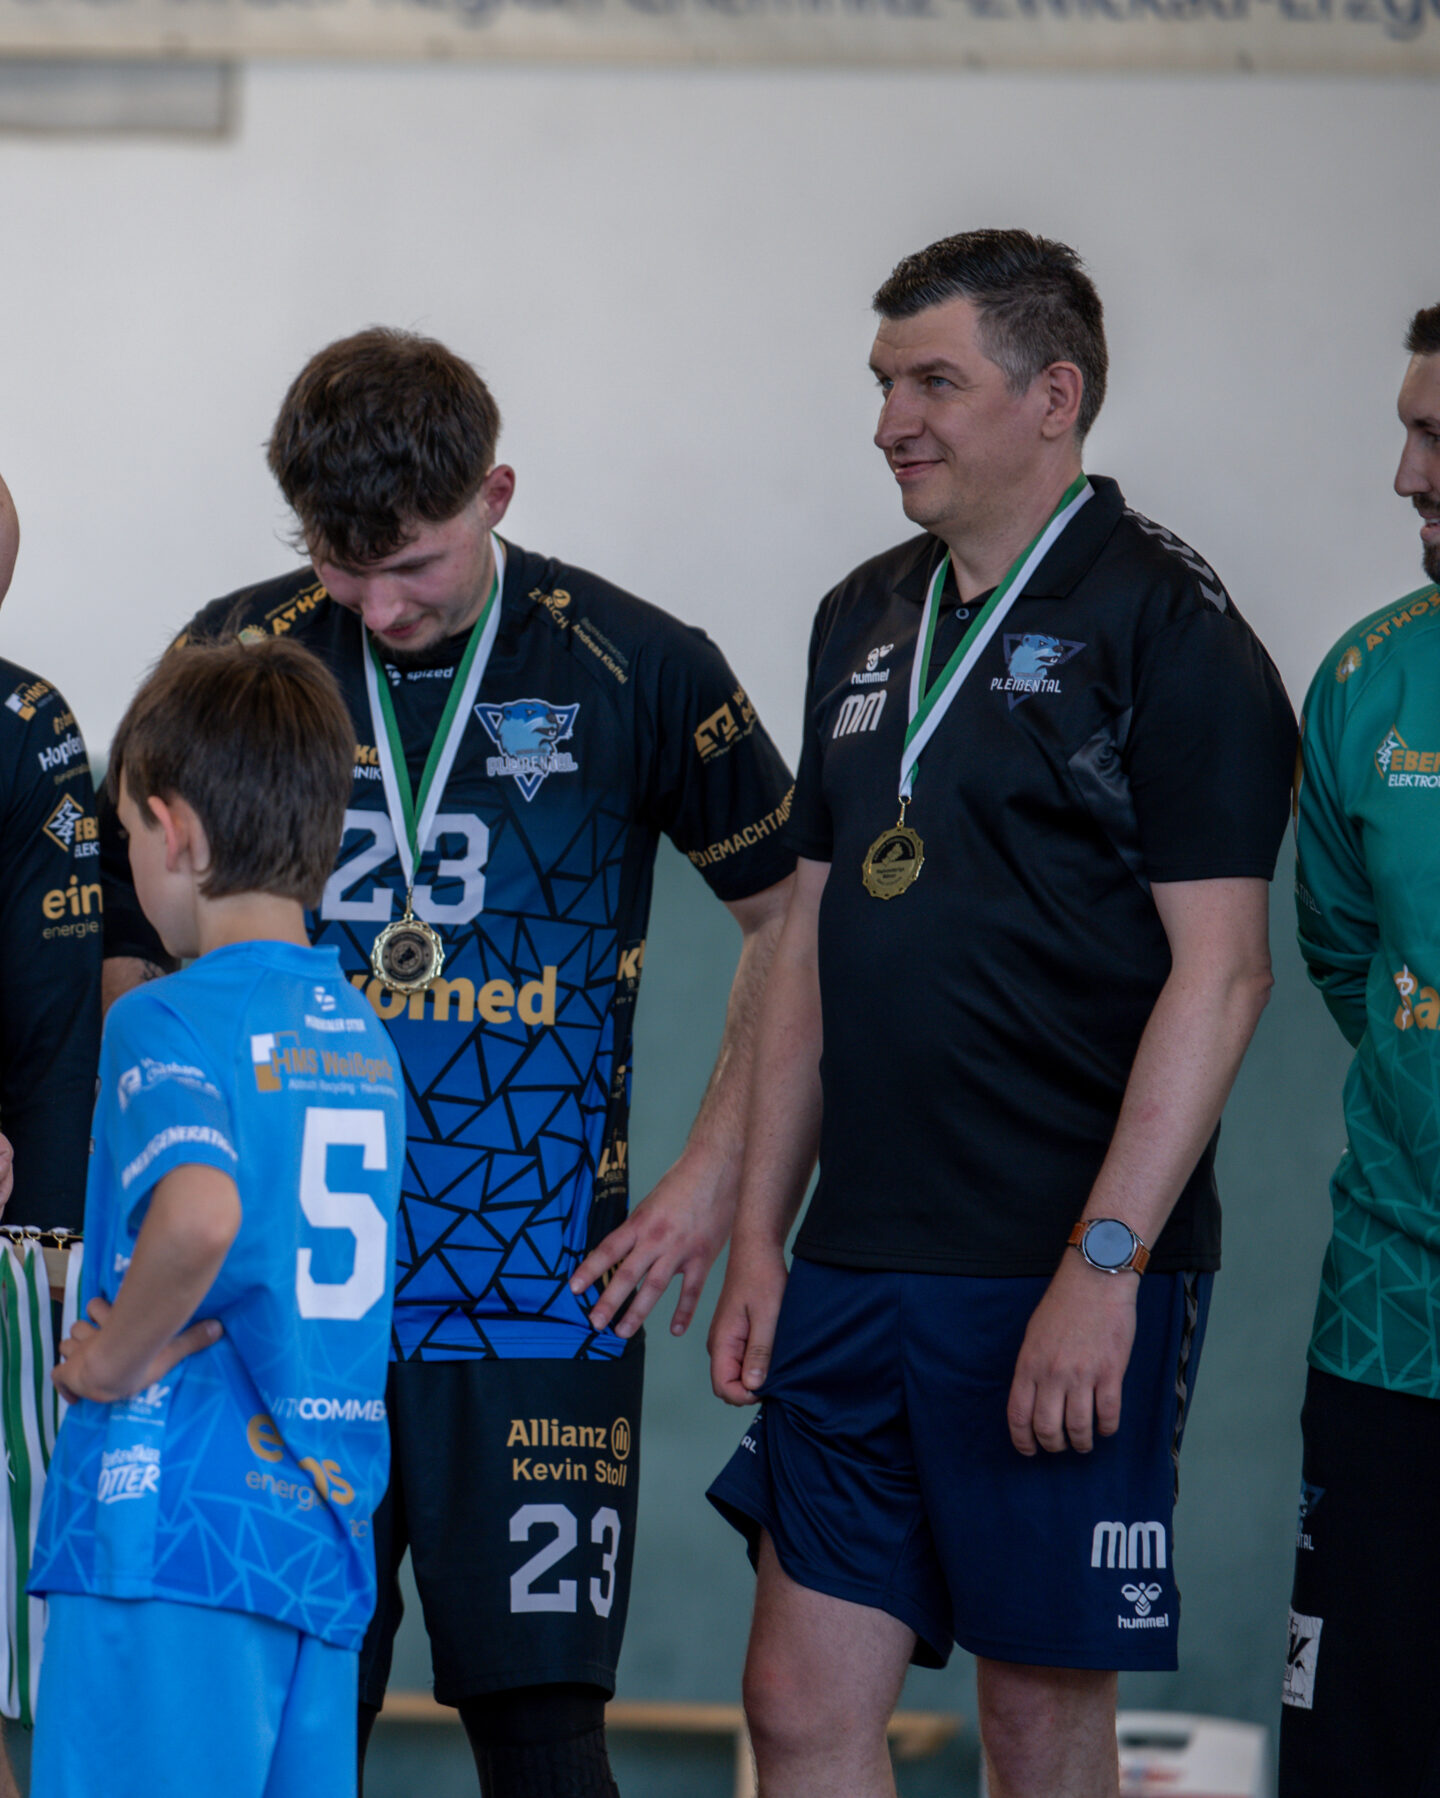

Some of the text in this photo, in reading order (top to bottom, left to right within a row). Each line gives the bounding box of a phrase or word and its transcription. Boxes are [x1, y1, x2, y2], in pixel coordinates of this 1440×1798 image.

[407, 666, 454, 681] spized
[851, 668, 890, 685] hummel
[832, 689, 888, 740] MM
[321, 808, 490, 926] 23
[42, 920, 99, 940] energie
[1393, 970, 1440, 1032] Sa
[269, 1048, 317, 1076] HMS
[295, 1107, 388, 1321] 5
[506, 1418, 608, 1449] Allianz
[512, 1457, 628, 1488] Kevin Stoll
[1090, 1521, 1167, 1569] MM
[509, 1503, 622, 1619] 23
[1117, 1613, 1170, 1629] hummel
